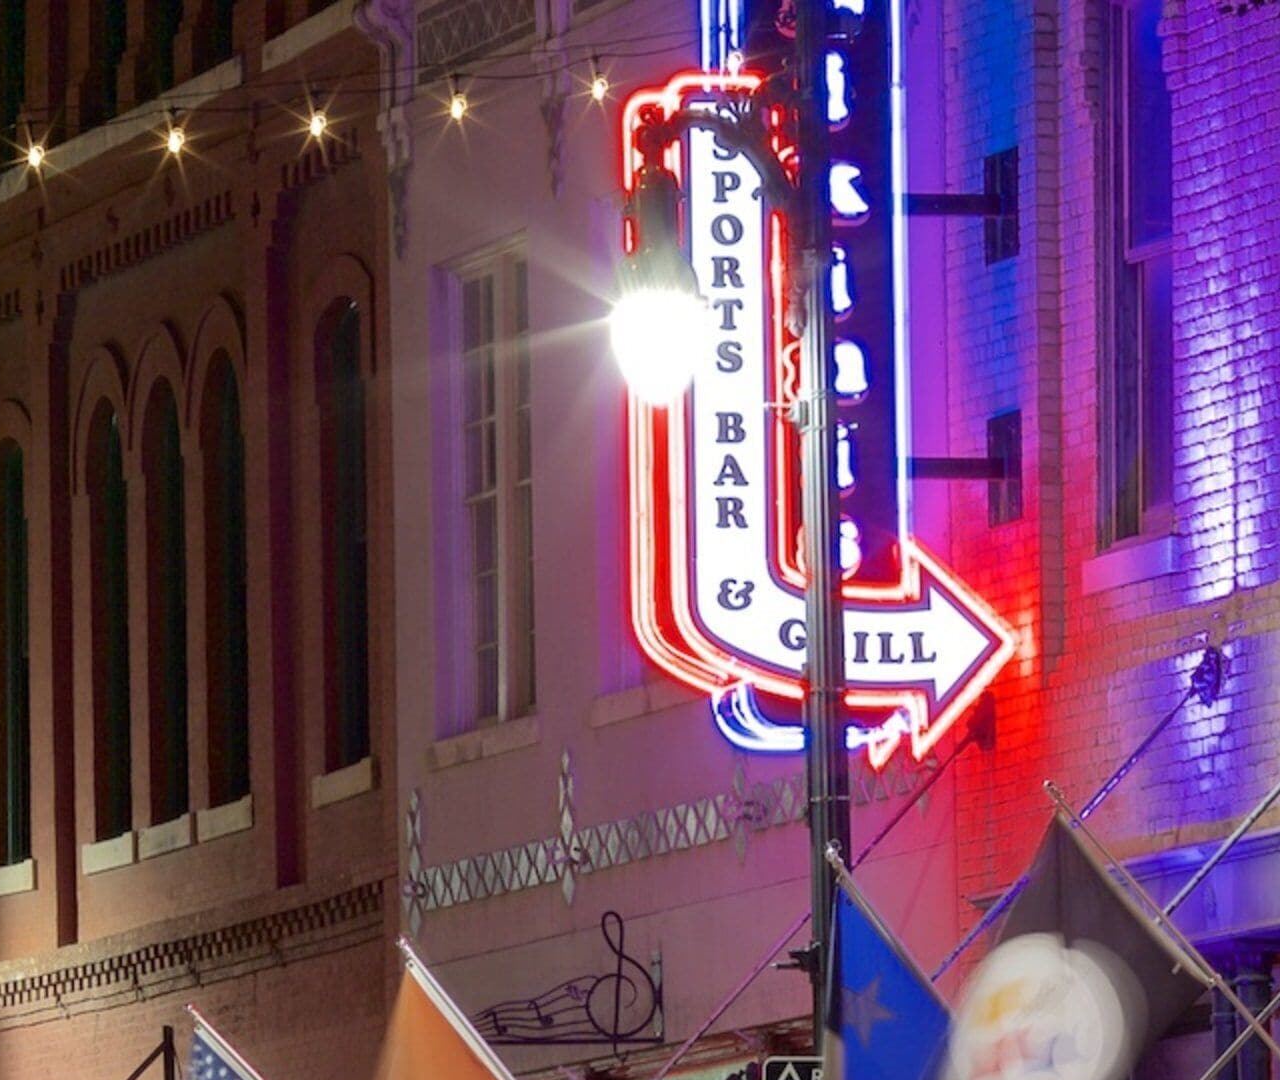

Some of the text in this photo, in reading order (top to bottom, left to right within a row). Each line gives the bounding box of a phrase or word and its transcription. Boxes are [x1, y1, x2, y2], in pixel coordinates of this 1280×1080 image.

[710, 100, 746, 374] SPORTS
[713, 411, 749, 529] BAR
[717, 578, 755, 611] &
[778, 617, 937, 665] GILL
